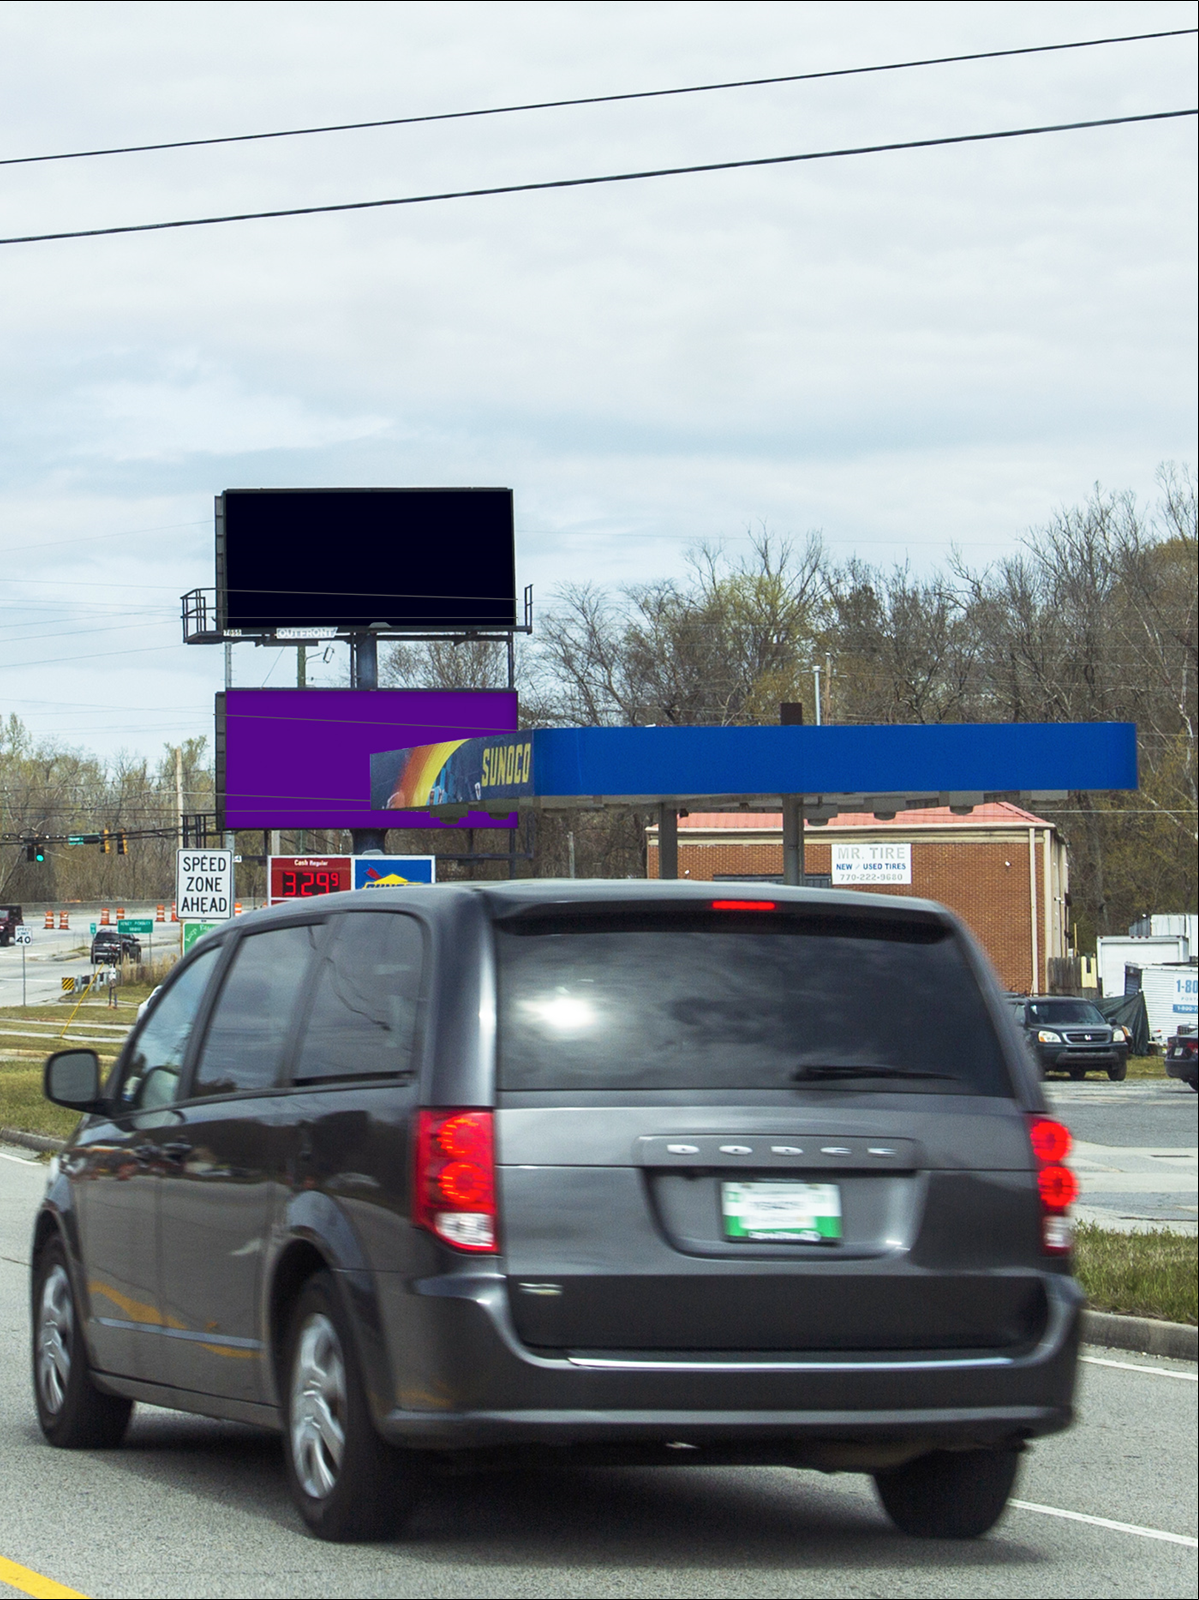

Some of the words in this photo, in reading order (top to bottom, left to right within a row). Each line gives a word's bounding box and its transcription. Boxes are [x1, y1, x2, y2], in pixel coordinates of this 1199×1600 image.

[279, 627, 335, 638] OUTFRONT
[481, 743, 531, 787] SUNOCO
[837, 847, 864, 860] MR.
[869, 847, 906, 860] TIRE
[183, 856, 227, 872] SPEED
[863, 862, 883, 870] USED
[885, 862, 907, 870] TIRES
[186, 876, 223, 892] ZONE
[181, 896, 228, 913] AHEAD
[16, 936, 31, 944] 40
